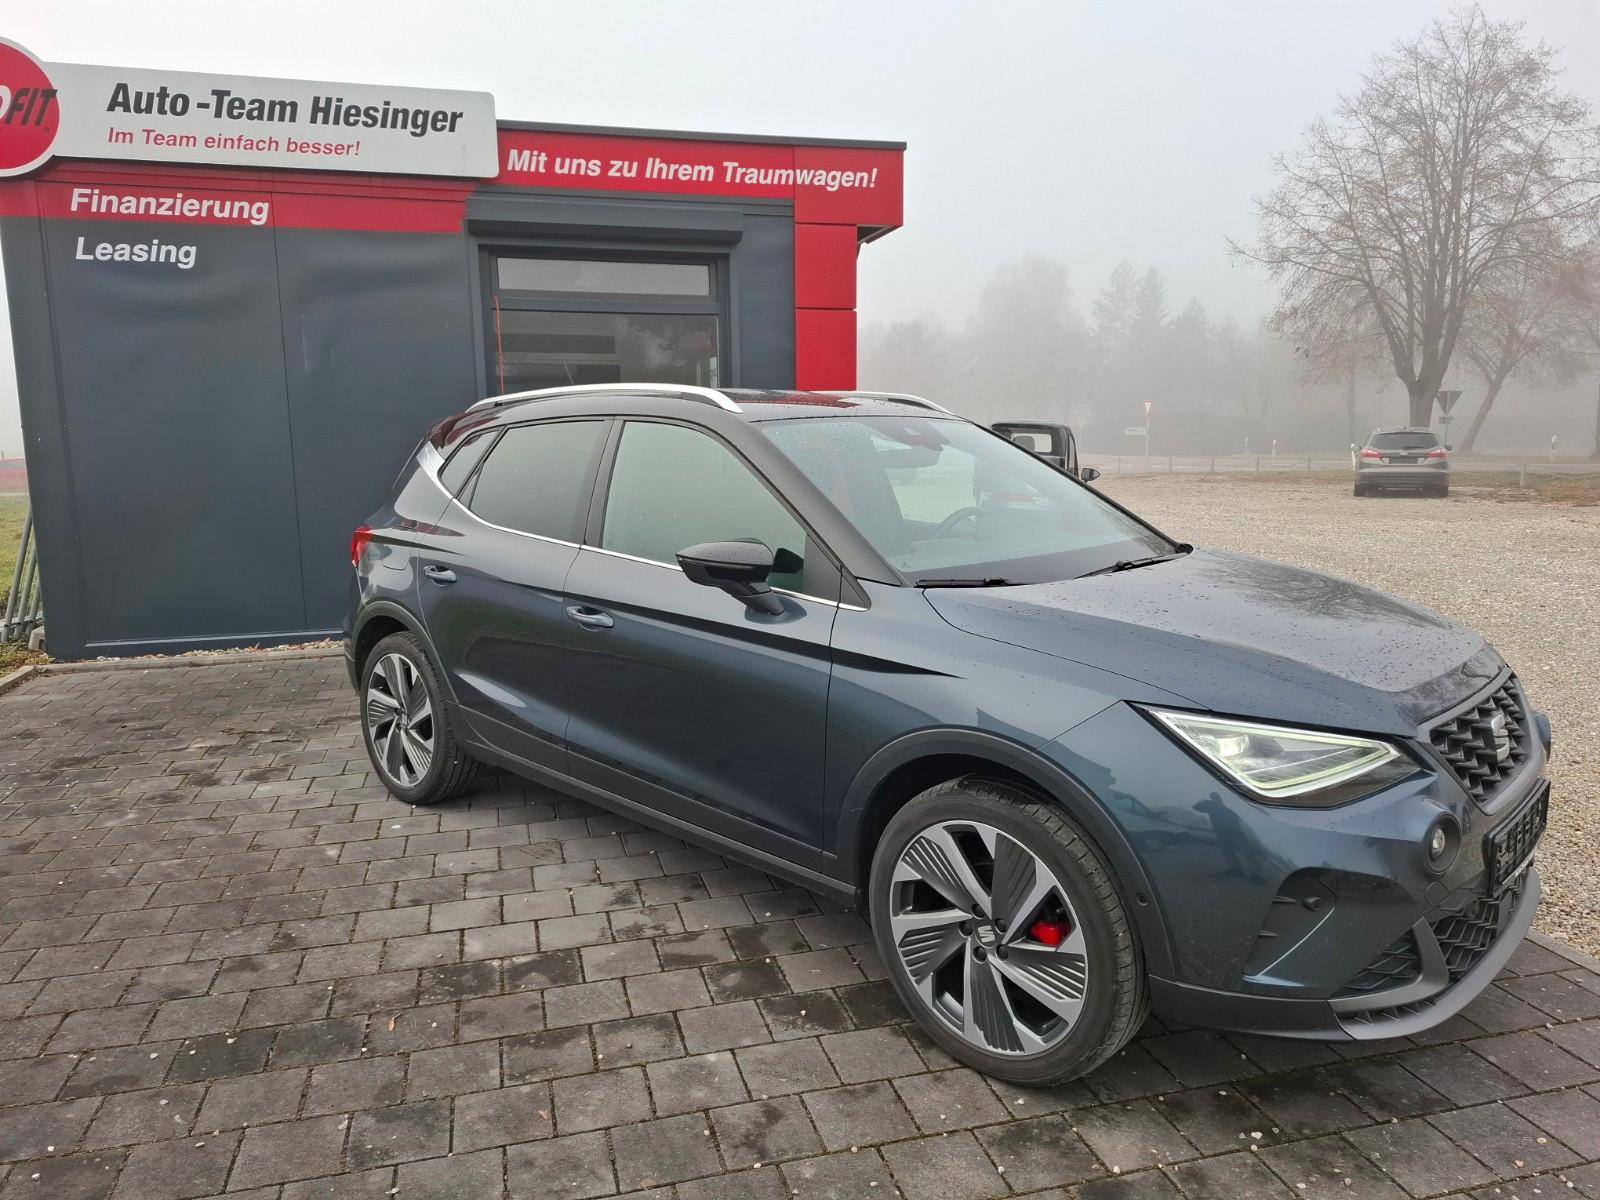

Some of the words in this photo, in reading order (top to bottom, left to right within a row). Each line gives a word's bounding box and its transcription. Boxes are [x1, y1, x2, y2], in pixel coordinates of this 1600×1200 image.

[309, 95, 464, 138] Hiesinger
[108, 128, 134, 143] Im
[142, 128, 197, 148] Team
[204, 134, 280, 152] einfach
[286, 138, 360, 156] besser!
[507, 148, 548, 173] Mit
[554, 157, 602, 177] uns
[608, 160, 639, 178] zu
[645, 157, 715, 182] Ihrem
[722, 161, 878, 192] Traumwagen!
[70, 187, 270, 226] Finanzierung
[75, 236, 197, 270] Leasing
